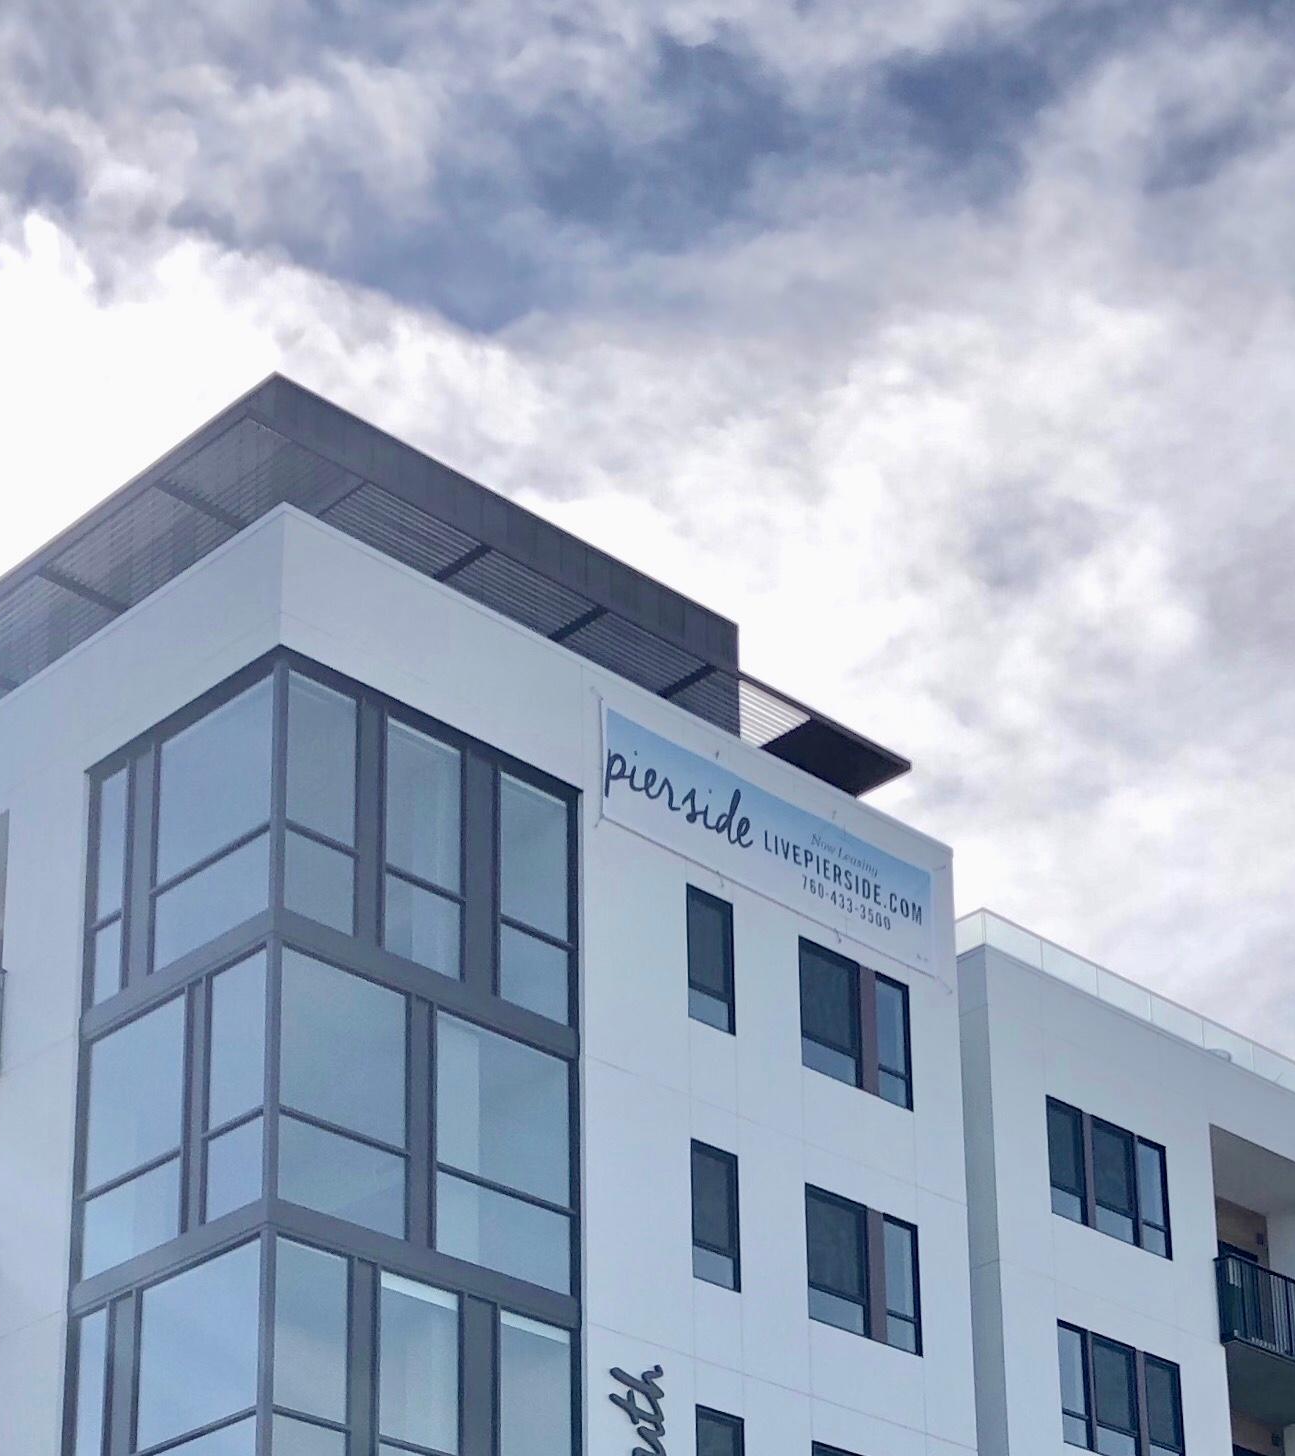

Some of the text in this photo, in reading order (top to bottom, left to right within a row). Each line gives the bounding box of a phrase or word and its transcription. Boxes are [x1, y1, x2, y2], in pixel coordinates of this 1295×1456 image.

[604, 748, 754, 848] pierside
[764, 829, 923, 927] LIVEPIERSIDE.COM
[809, 832, 835, 855] Now
[801, 874, 892, 931] 760-433-3500
